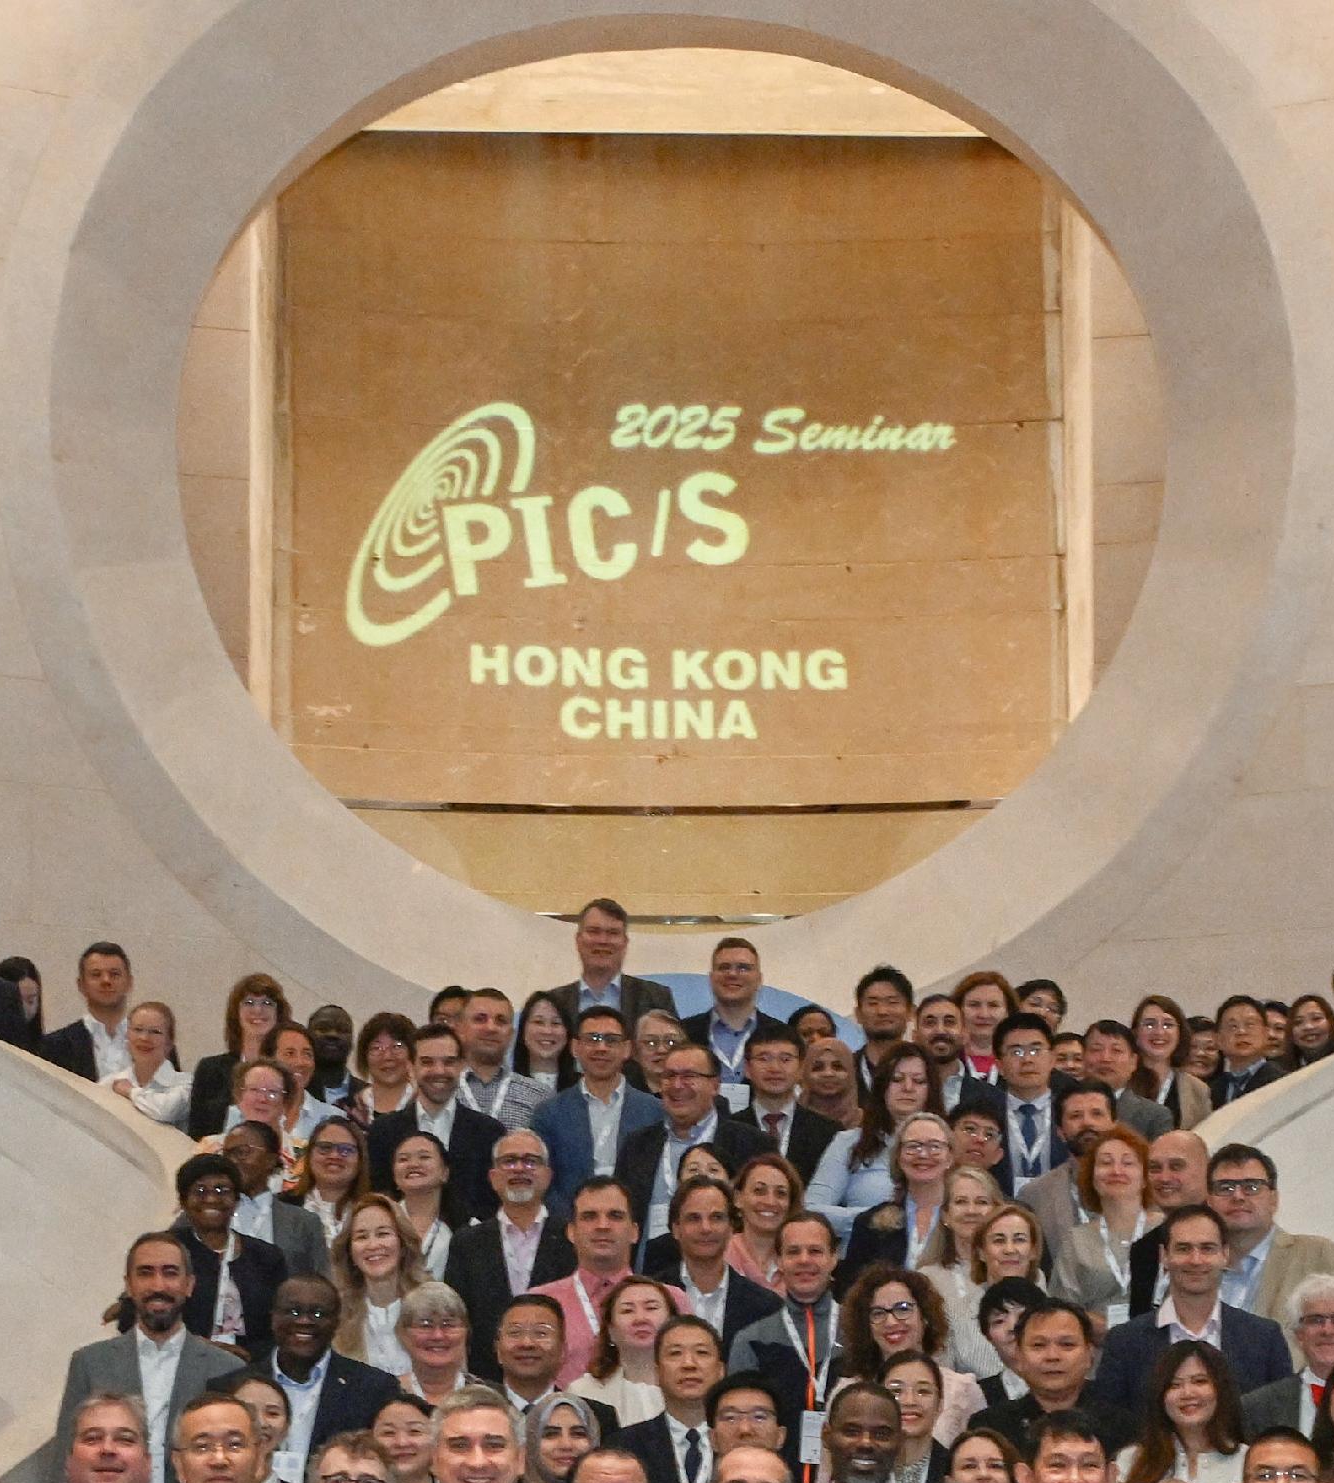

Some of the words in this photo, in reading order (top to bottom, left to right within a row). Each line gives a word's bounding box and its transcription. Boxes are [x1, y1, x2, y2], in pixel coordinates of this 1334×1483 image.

[611, 405, 741, 450] 2025
[754, 408, 957, 454] Seminar
[443, 471, 750, 596] PIC/S
[469, 645, 649, 689] HONG
[672, 649, 848, 691] KONG
[560, 697, 758, 740] CHINA
